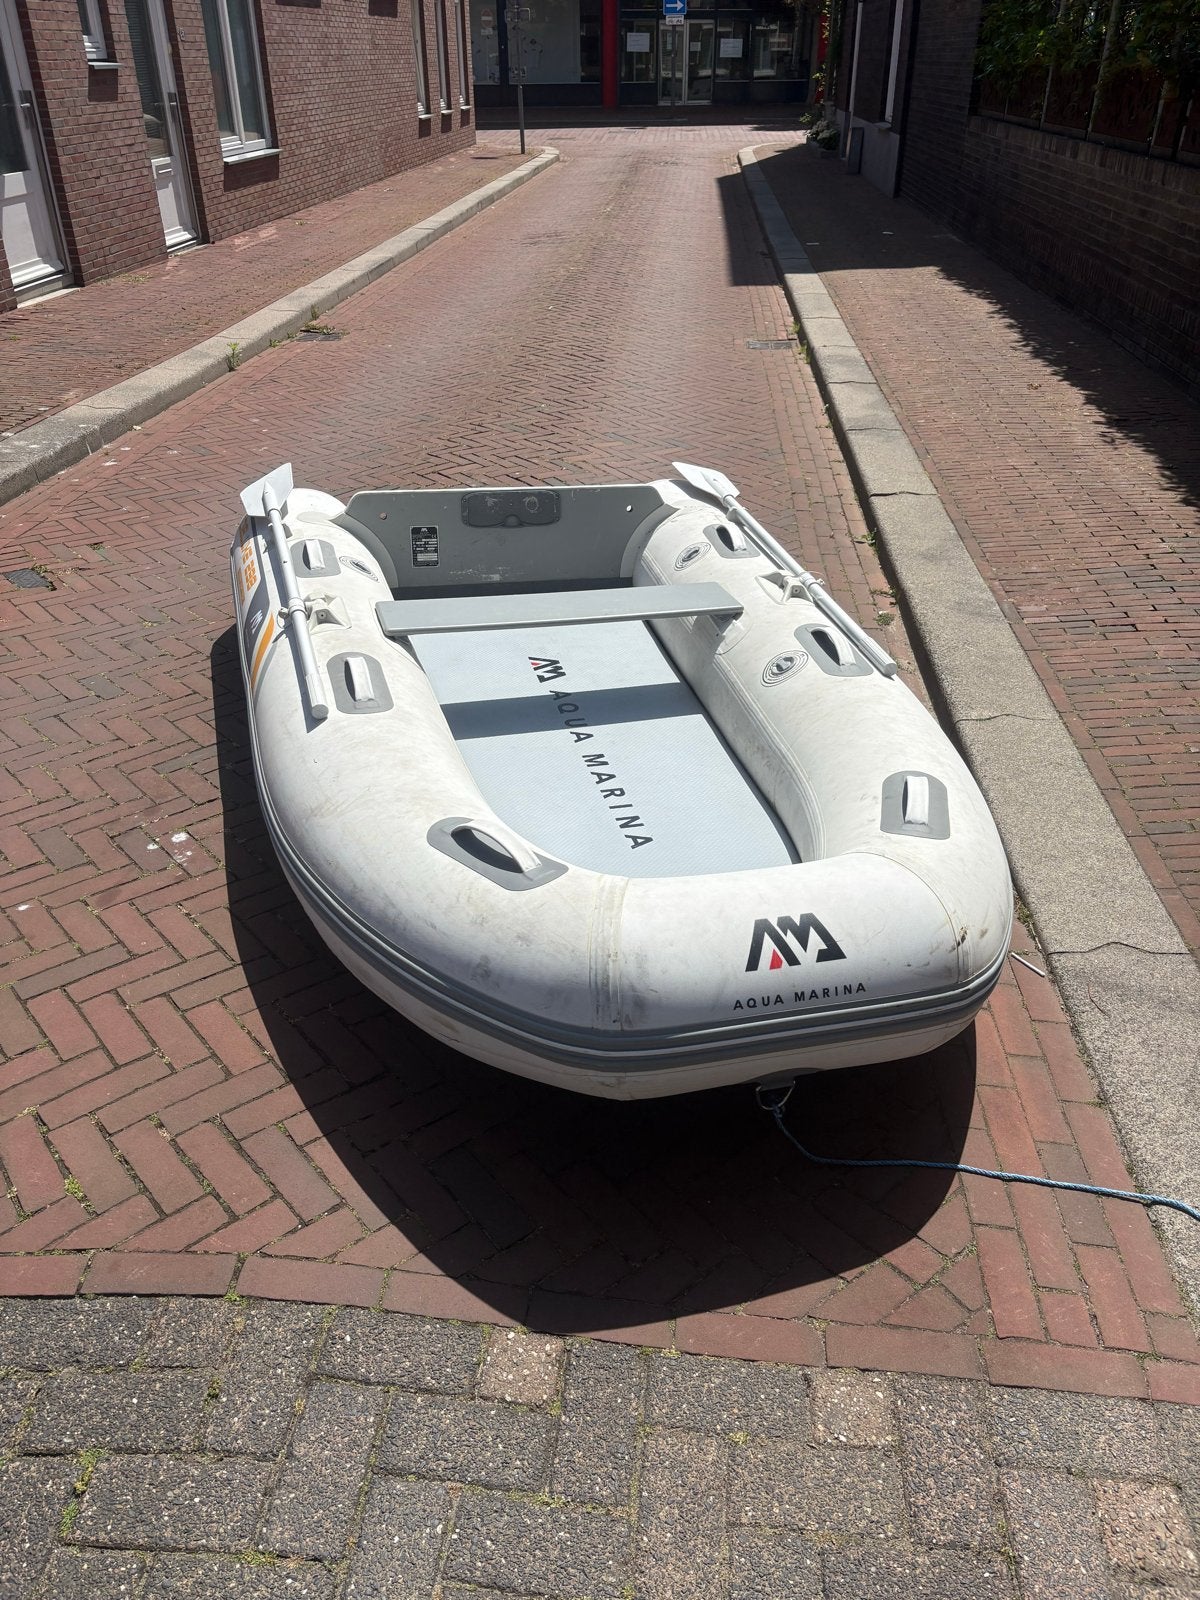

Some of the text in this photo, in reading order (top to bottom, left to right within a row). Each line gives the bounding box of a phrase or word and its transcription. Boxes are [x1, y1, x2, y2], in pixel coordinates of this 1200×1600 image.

[549, 690, 654, 850] AQUA MARINA
[733, 983, 867, 1011] AQUA MARINA
